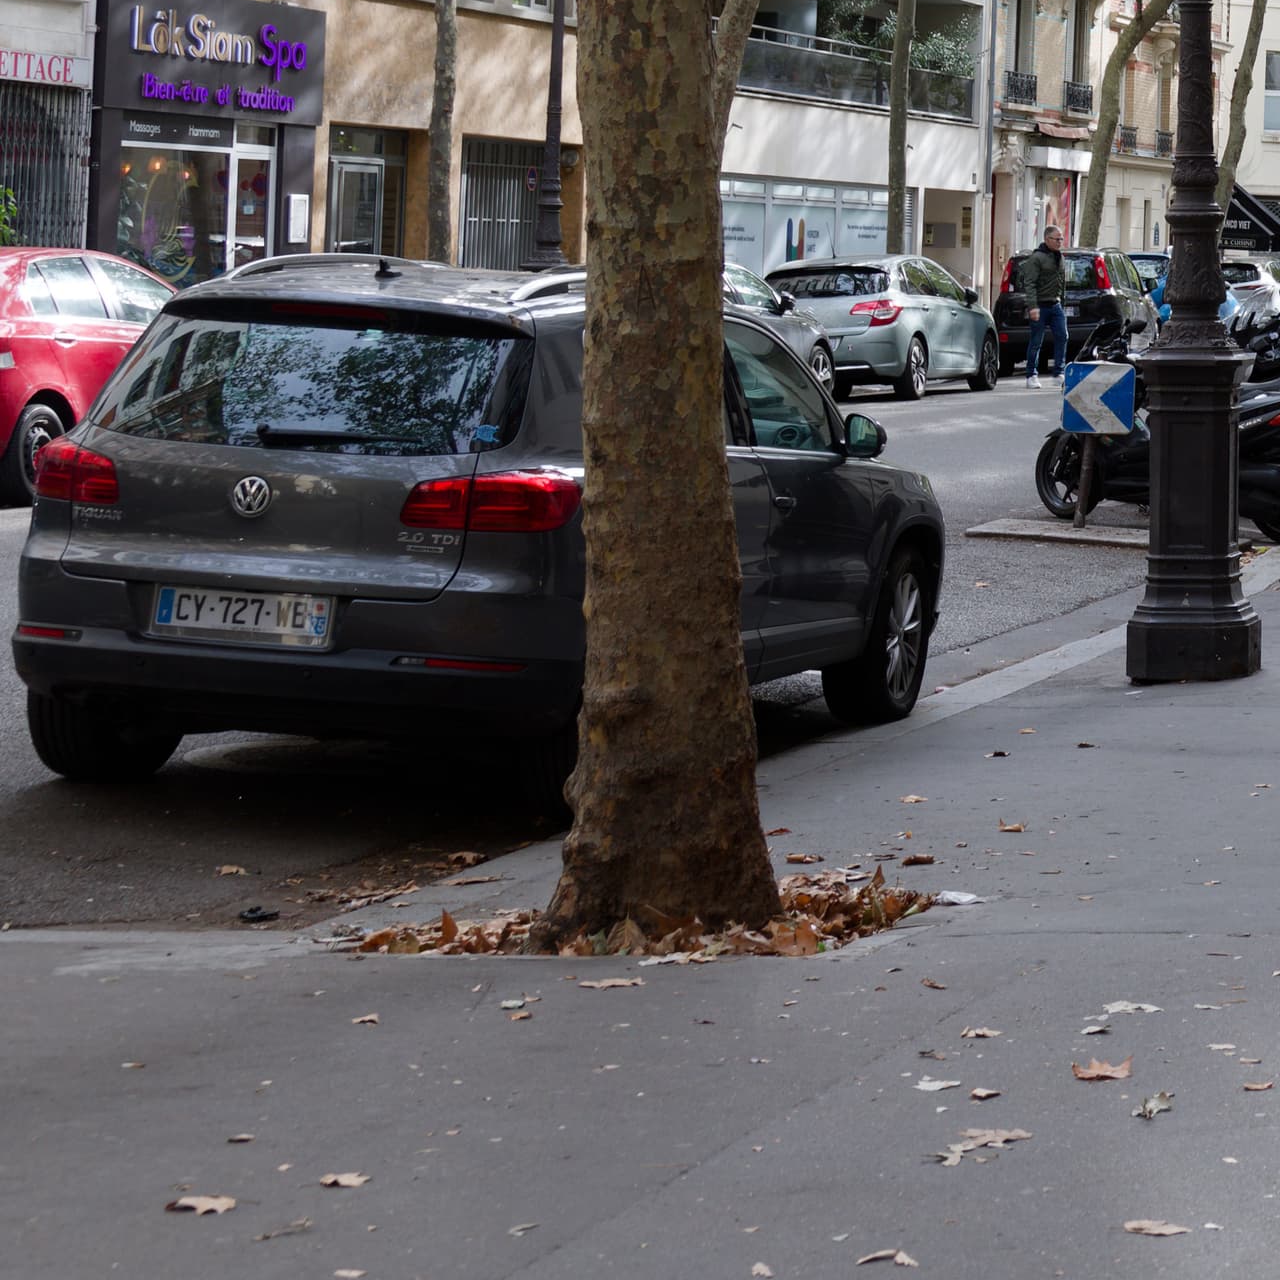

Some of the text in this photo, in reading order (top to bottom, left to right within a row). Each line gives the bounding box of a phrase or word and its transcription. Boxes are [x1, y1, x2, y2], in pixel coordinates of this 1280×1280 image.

[187, 14, 255, 65] Siam
[259, 23, 307, 82] Spa
[0, 50, 75, 83] ETTAGE
[216, 83, 231, 106] et
[238, 84, 296, 112] tradition
[130, 120, 160, 137] Massages
[188, 124, 220, 138] Hammam
[431, 534, 460, 545] TDI
